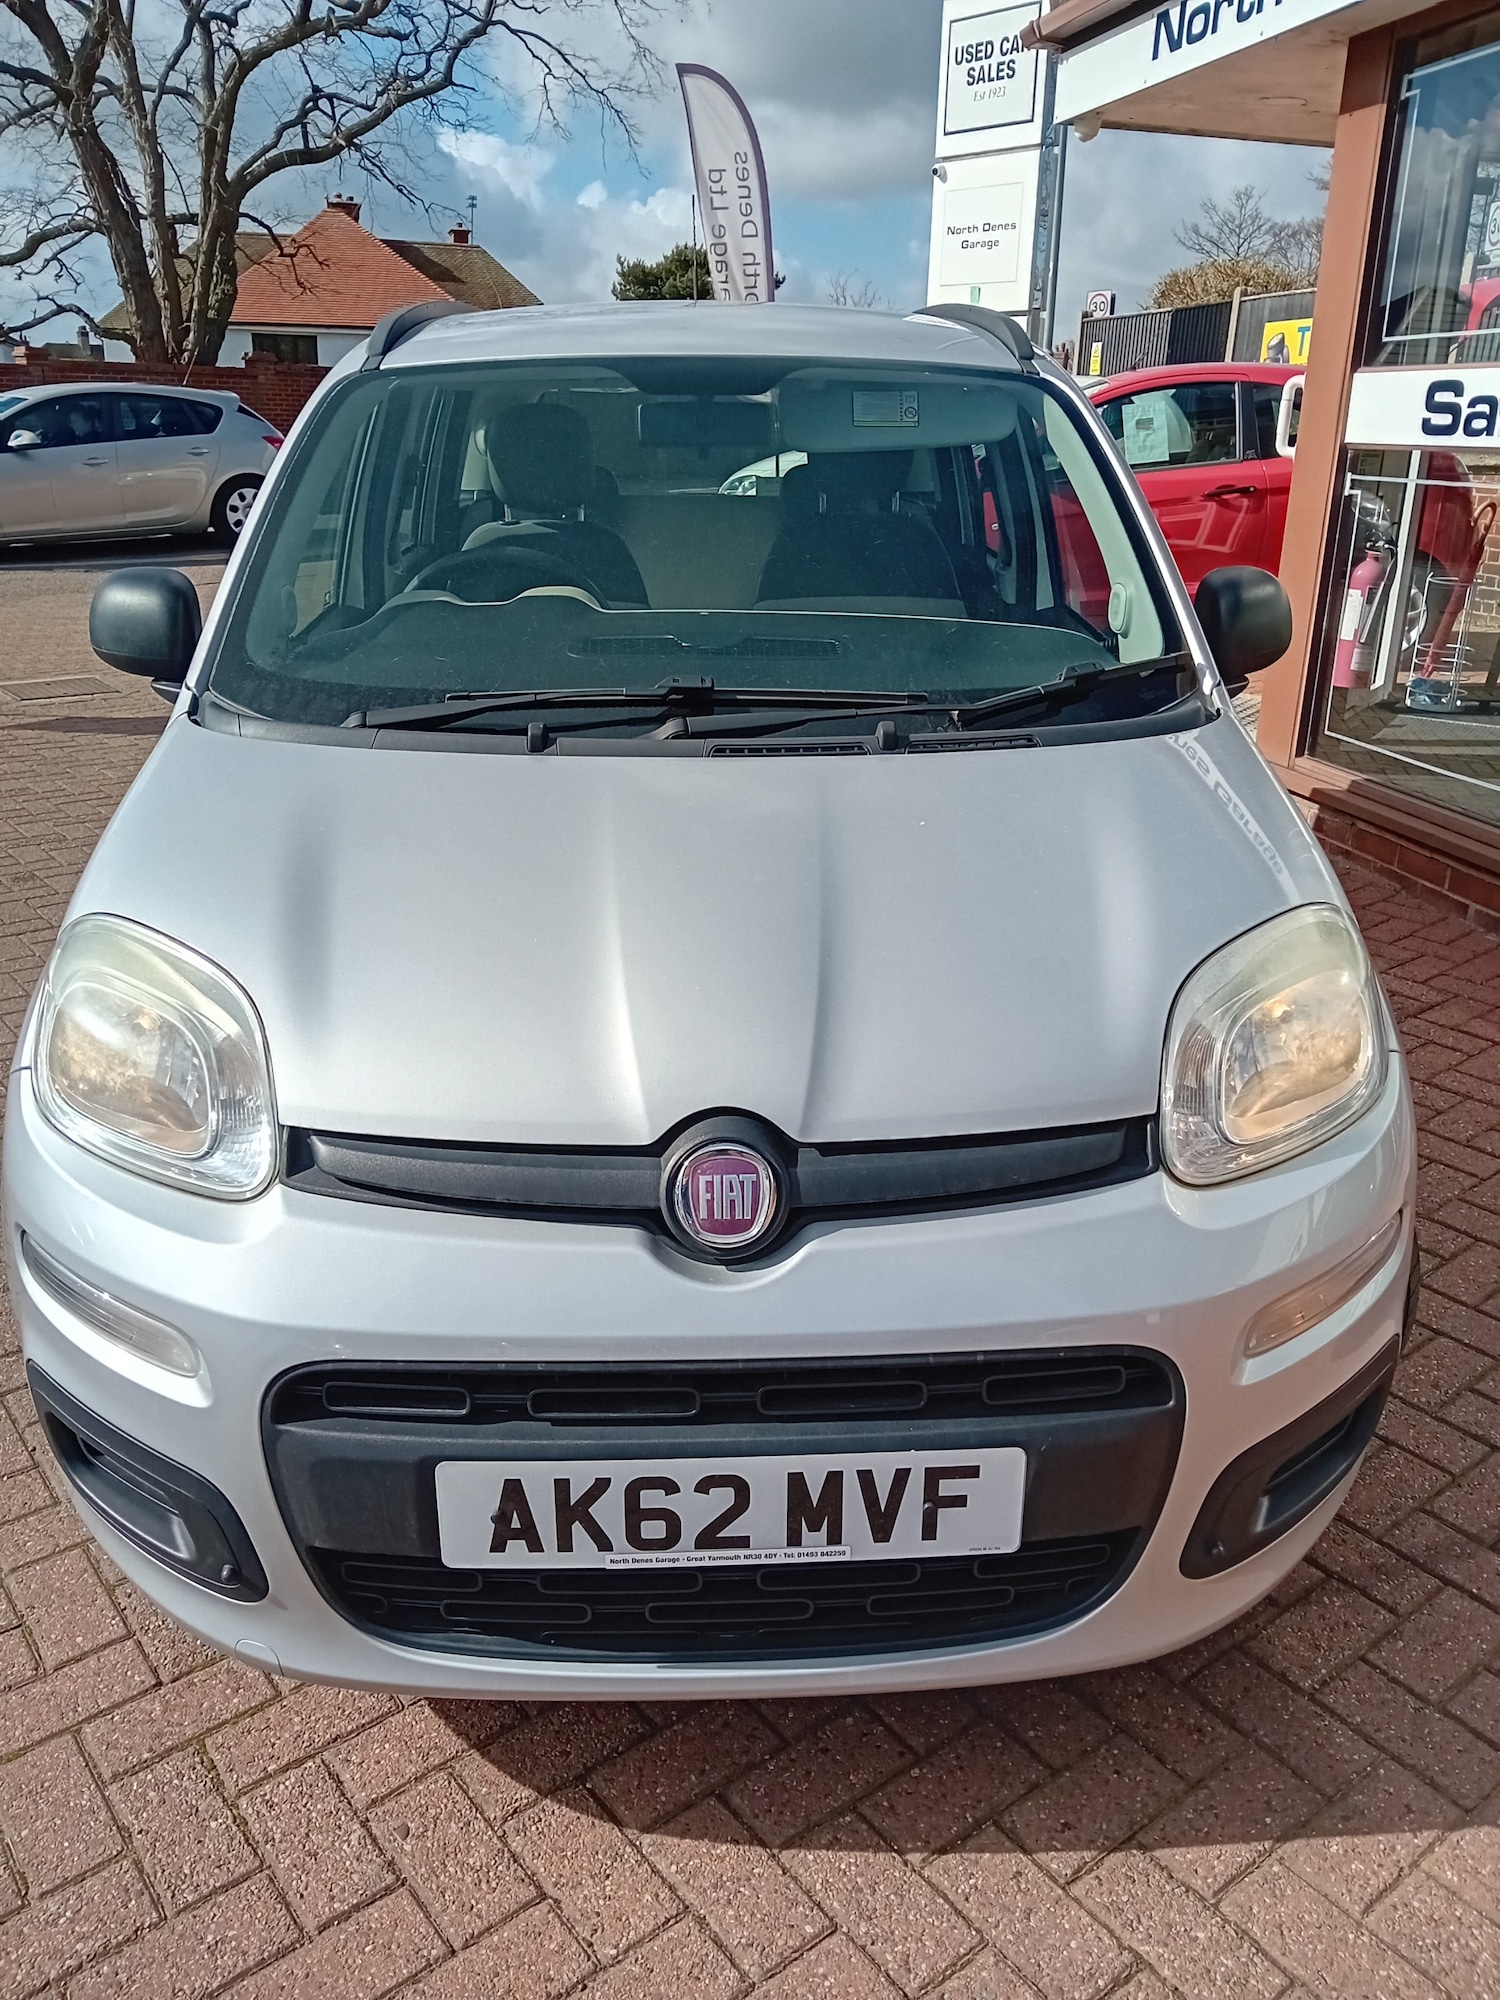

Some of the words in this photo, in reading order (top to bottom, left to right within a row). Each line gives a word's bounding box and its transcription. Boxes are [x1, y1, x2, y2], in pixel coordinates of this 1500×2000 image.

[1151, 0, 1283, 62] Nor
[954, 39, 995, 66] USED
[999, 34, 1031, 57] CA
[966, 58, 1017, 87] SALES
[973, 90, 986, 102] Est
[988, 86, 1007, 100] 1923
[946, 224, 979, 236] North
[982, 222, 1017, 232] Denes
[961, 239, 1000, 250] Garage
[1091, 300, 1106, 313] 30
[698, 1173, 757, 1220] FIAT
[489, 1473, 751, 1554] AK62
[786, 1464, 981, 1548] MVF
[655, 1556, 680, 1564] Garage
[707, 1554, 741, 1562] Yarmouth
